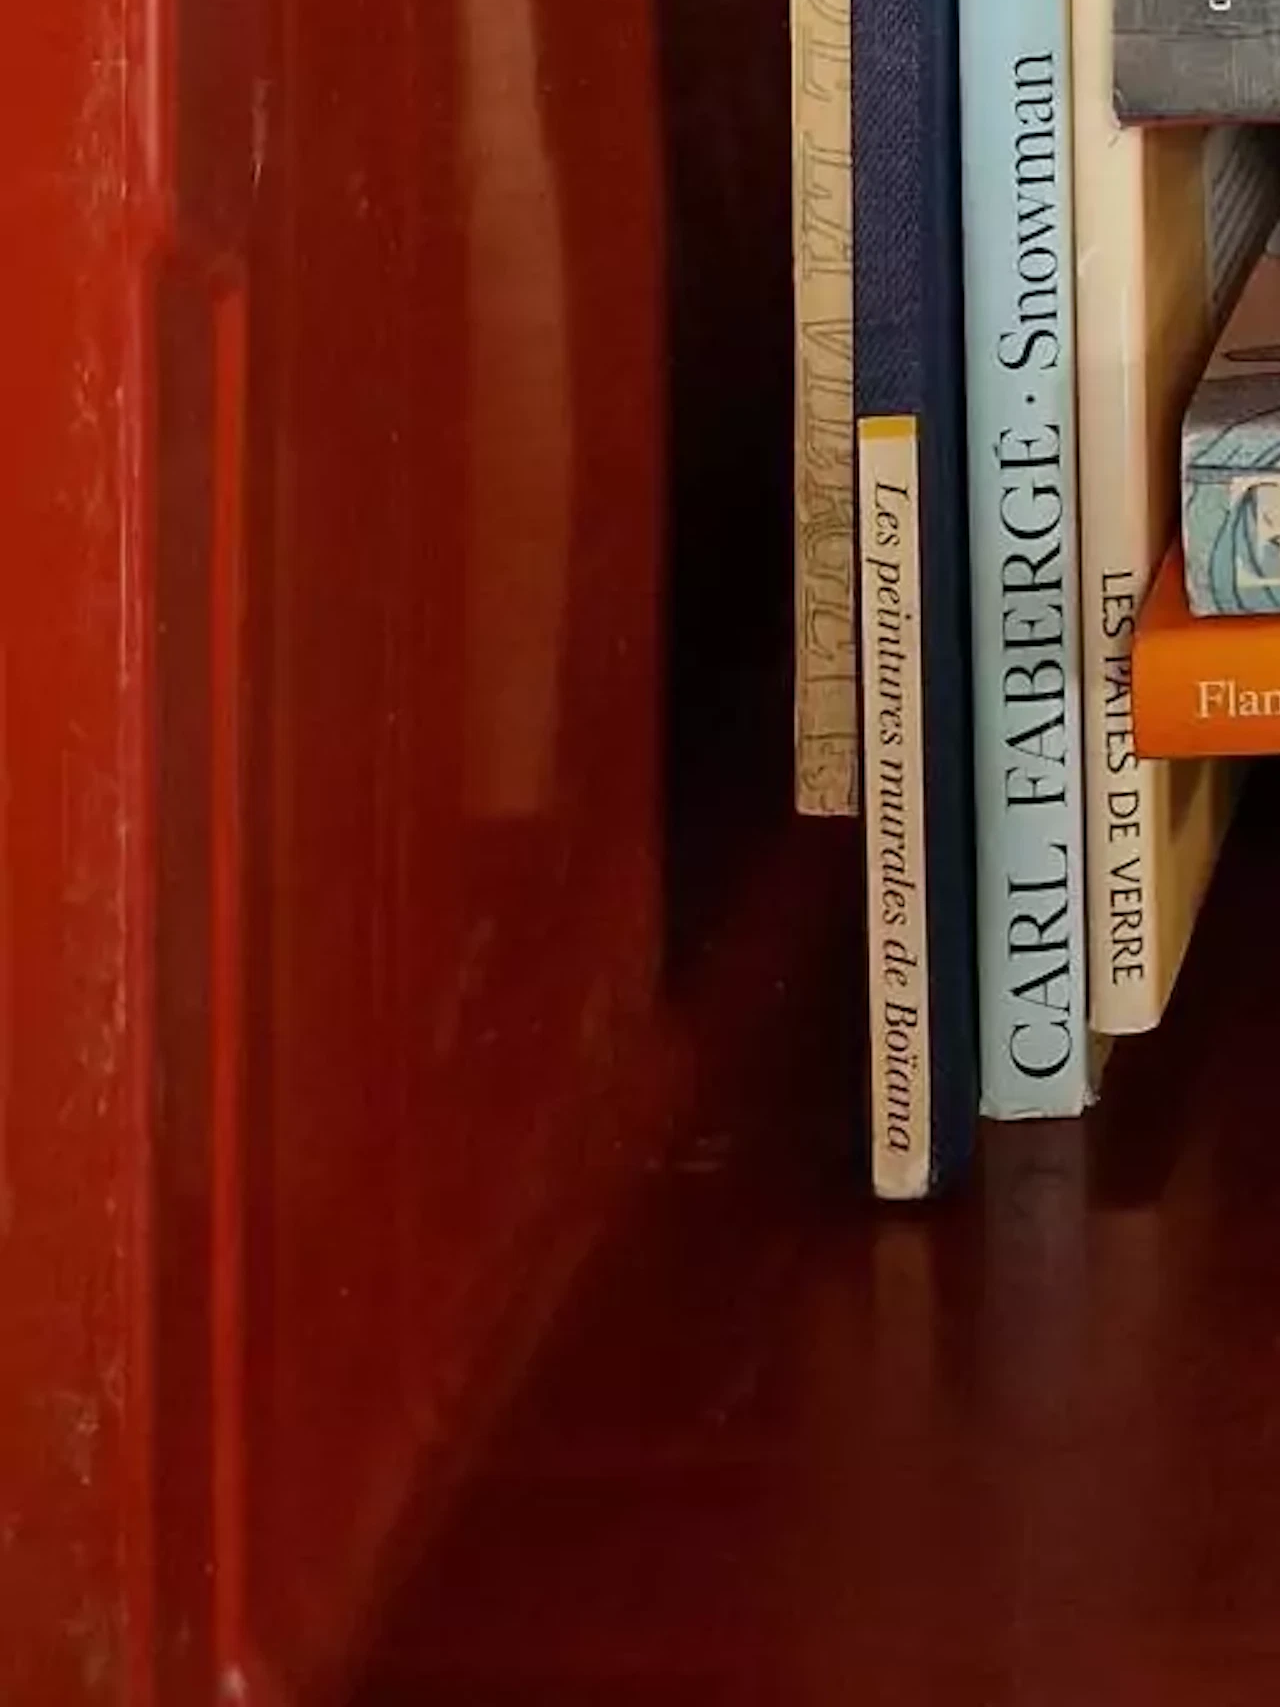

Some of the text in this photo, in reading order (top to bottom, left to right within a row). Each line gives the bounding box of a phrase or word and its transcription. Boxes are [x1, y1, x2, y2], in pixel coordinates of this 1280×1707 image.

[869, 480, 920, 1153] Les peintures murales de Boïana
[992, 50, 1073, 1080] CARL FABERGÉ Snowman
[1101, 571, 1144, 986] LES DE VERRE
